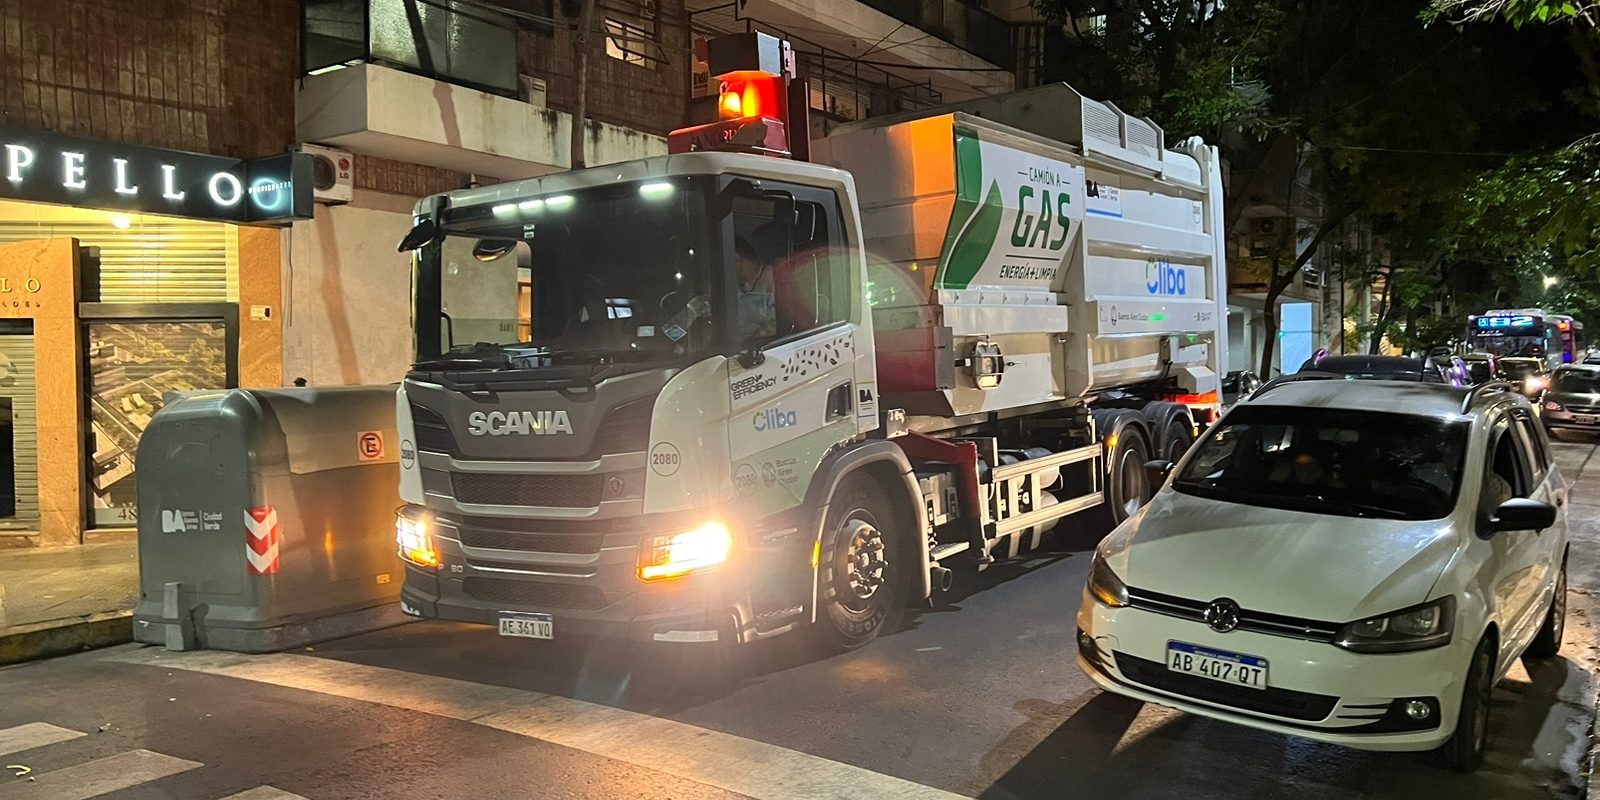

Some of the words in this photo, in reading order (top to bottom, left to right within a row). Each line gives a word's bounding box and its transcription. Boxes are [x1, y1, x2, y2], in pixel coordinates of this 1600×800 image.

[5, 143, 242, 206] PELLO
[339, 172, 349, 180] LG
[1029, 167, 1054, 186] CAMIÓN
[1056, 173, 1061, 186] A
[1011, 185, 1070, 251] GAS
[731, 374, 760, 392] GREEN
[733, 376, 777, 400] EFFICIENCY
[468, 410, 573, 435] SCANIA
[653, 453, 678, 465] 2080
[203, 512, 222, 521] Ciudad
[502, 620, 514, 634] AE
[516, 621, 536, 636] 361
[1172, 652, 1193, 672] AB
[1200, 658, 1233, 680] 407
[1239, 666, 1262, 686] QT
